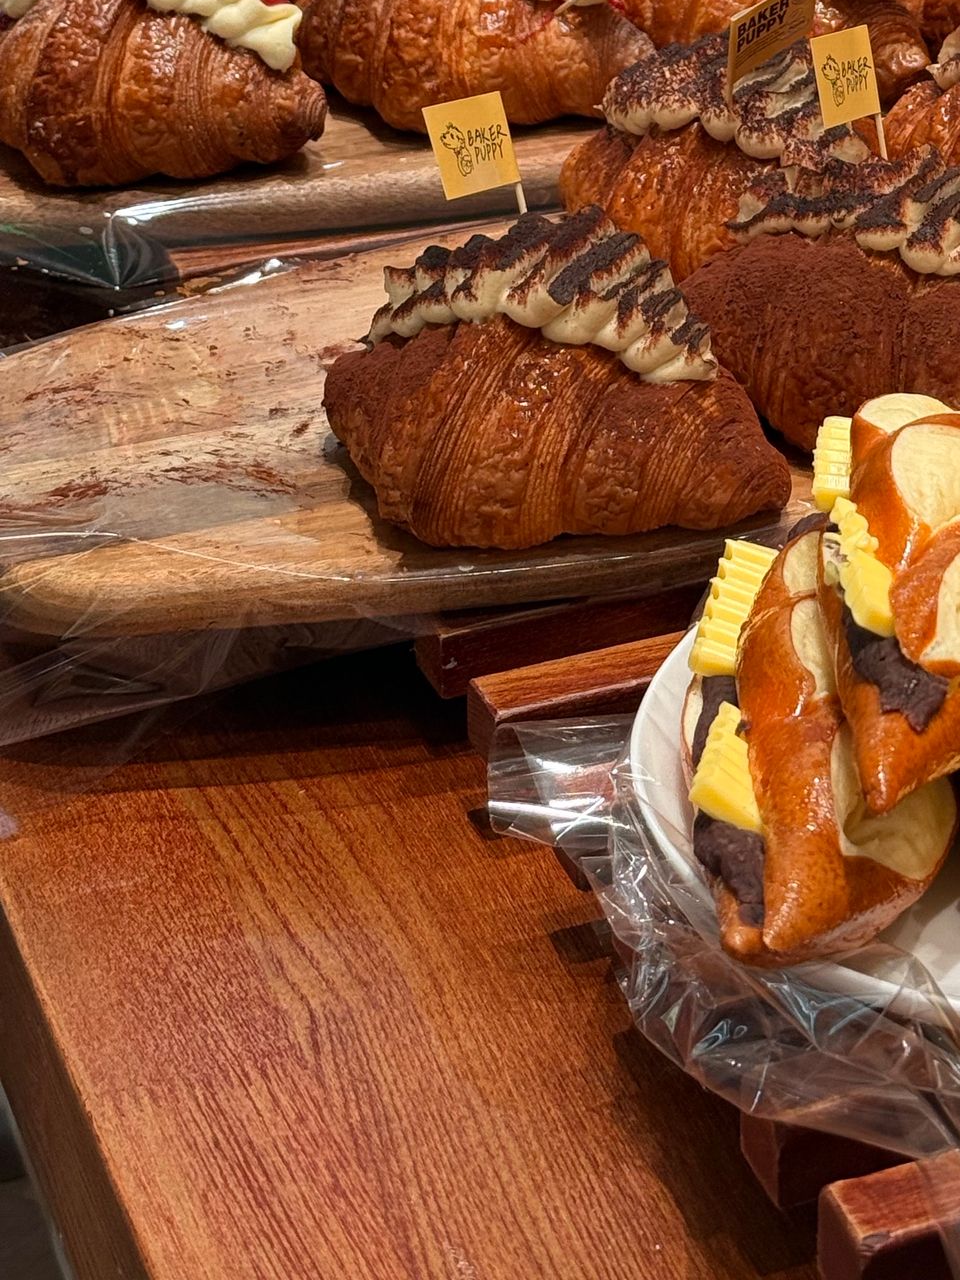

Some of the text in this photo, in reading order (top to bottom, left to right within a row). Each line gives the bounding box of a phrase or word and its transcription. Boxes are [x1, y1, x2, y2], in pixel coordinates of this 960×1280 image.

[737, 9, 787, 53] PUPPY
[841, 56, 872, 78] BAKER
[846, 72, 868, 95] PUPPY
[467, 124, 507, 147] BAKER
[474, 139, 503, 164] PUPPY
